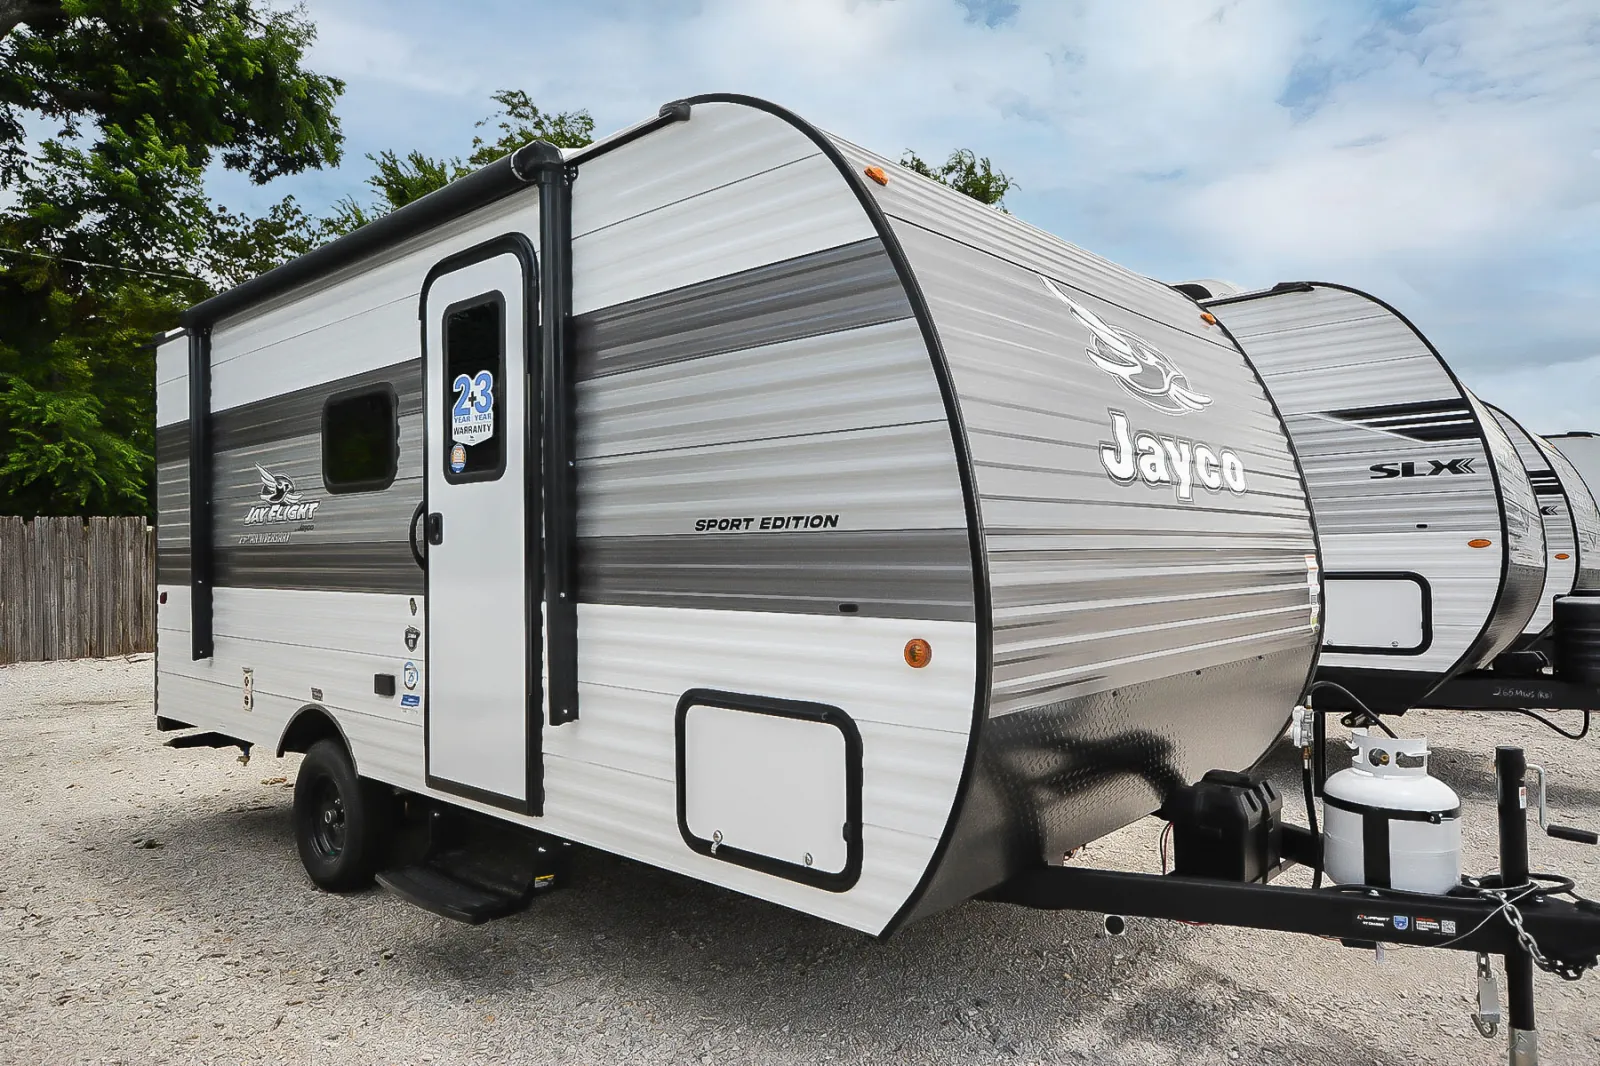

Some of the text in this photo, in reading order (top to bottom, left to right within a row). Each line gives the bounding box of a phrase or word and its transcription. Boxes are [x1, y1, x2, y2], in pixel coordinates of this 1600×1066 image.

[454, 414, 491, 423] YEAR YEAR
[454, 424, 491, 435] WARRANTY
[1099, 408, 1247, 503] Jayco
[1369, 457, 1476, 479] SLX
[244, 500, 319, 525] JAY FLIGHT
[694, 514, 839, 532] SPORT EDITION
